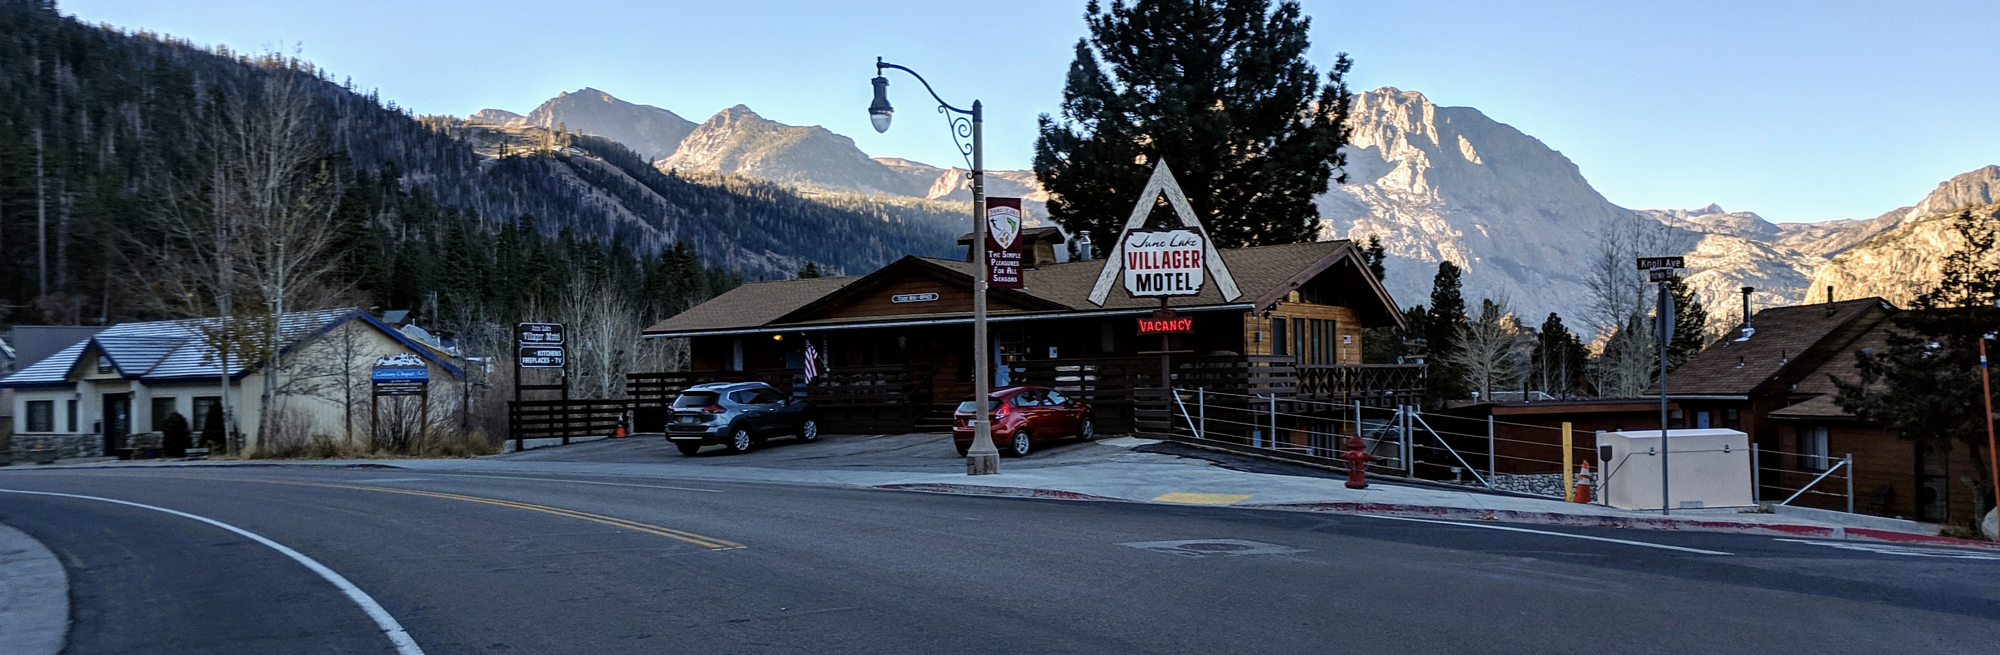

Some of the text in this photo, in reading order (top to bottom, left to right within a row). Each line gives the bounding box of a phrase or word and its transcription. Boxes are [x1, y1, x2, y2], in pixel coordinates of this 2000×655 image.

[1130, 234, 1197, 247] June Lake
[1128, 250, 1200, 270] VILLAGER
[1641, 259, 1680, 268] Knoll Ave
[1136, 273, 1193, 292] MOTEL
[1140, 319, 1192, 332] VACANCY
[523, 332, 560, 342] Villager Motel
